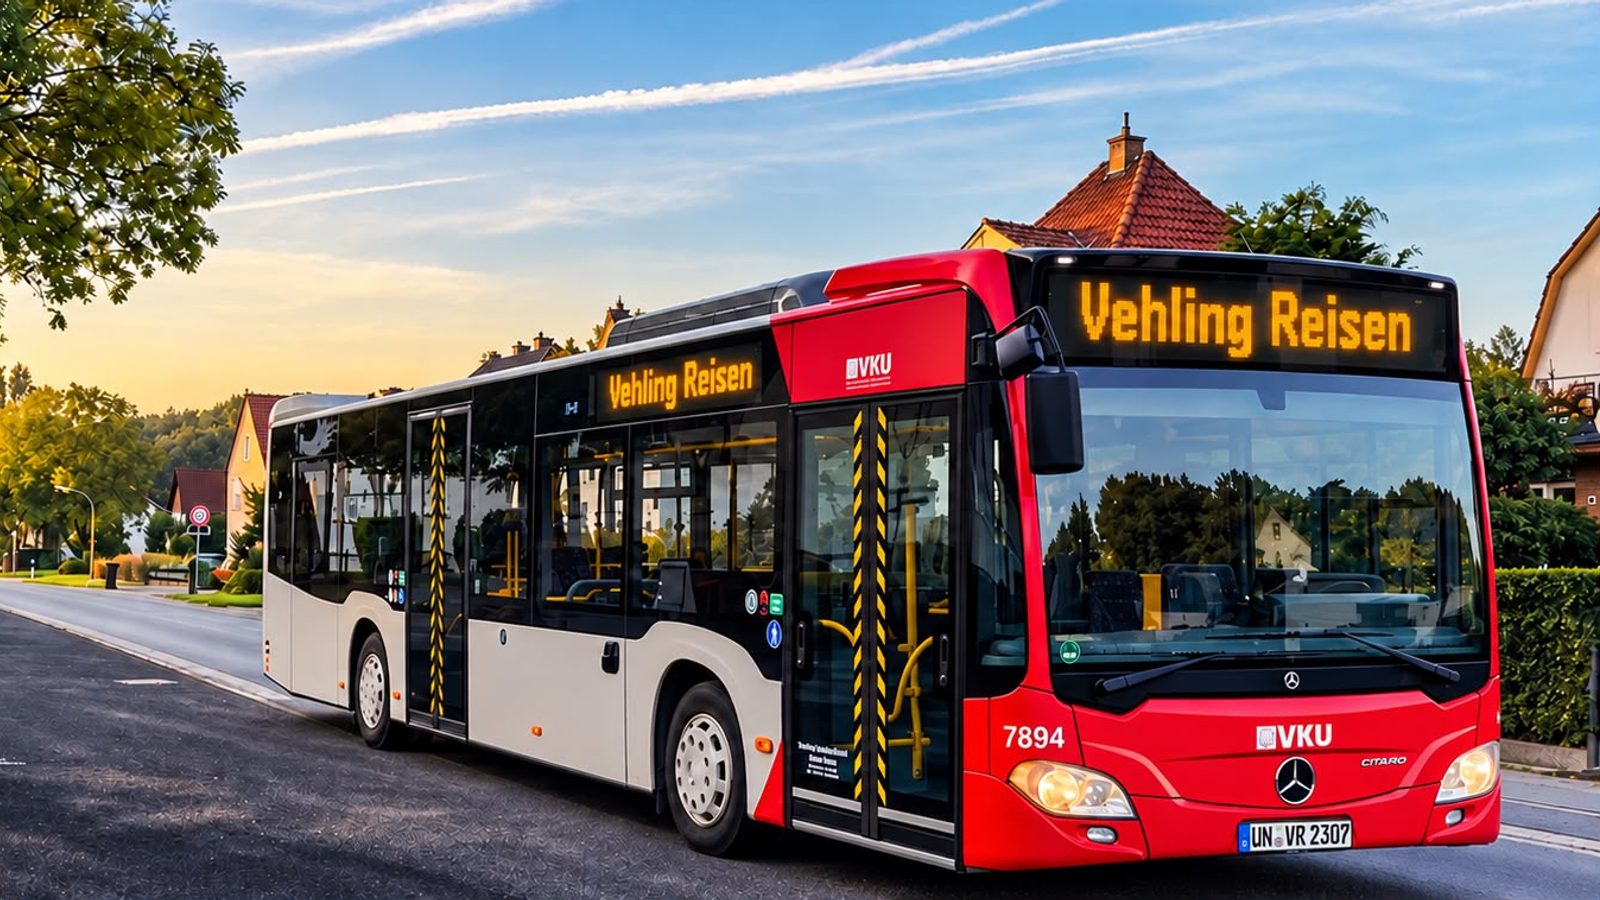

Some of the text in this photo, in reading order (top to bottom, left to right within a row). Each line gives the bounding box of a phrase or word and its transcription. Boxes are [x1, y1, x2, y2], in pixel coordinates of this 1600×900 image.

[1081, 281, 1411, 358] Vehling Reisen
[858, 352, 892, 377] VKU
[609, 357, 752, 410] Vehling Reisen
[1003, 725, 1065, 749] 7894
[1277, 723, 1333, 749] VKU
[1361, 756, 1407, 767] CITARO
[1252, 823, 1350, 847] UN VR 2307
